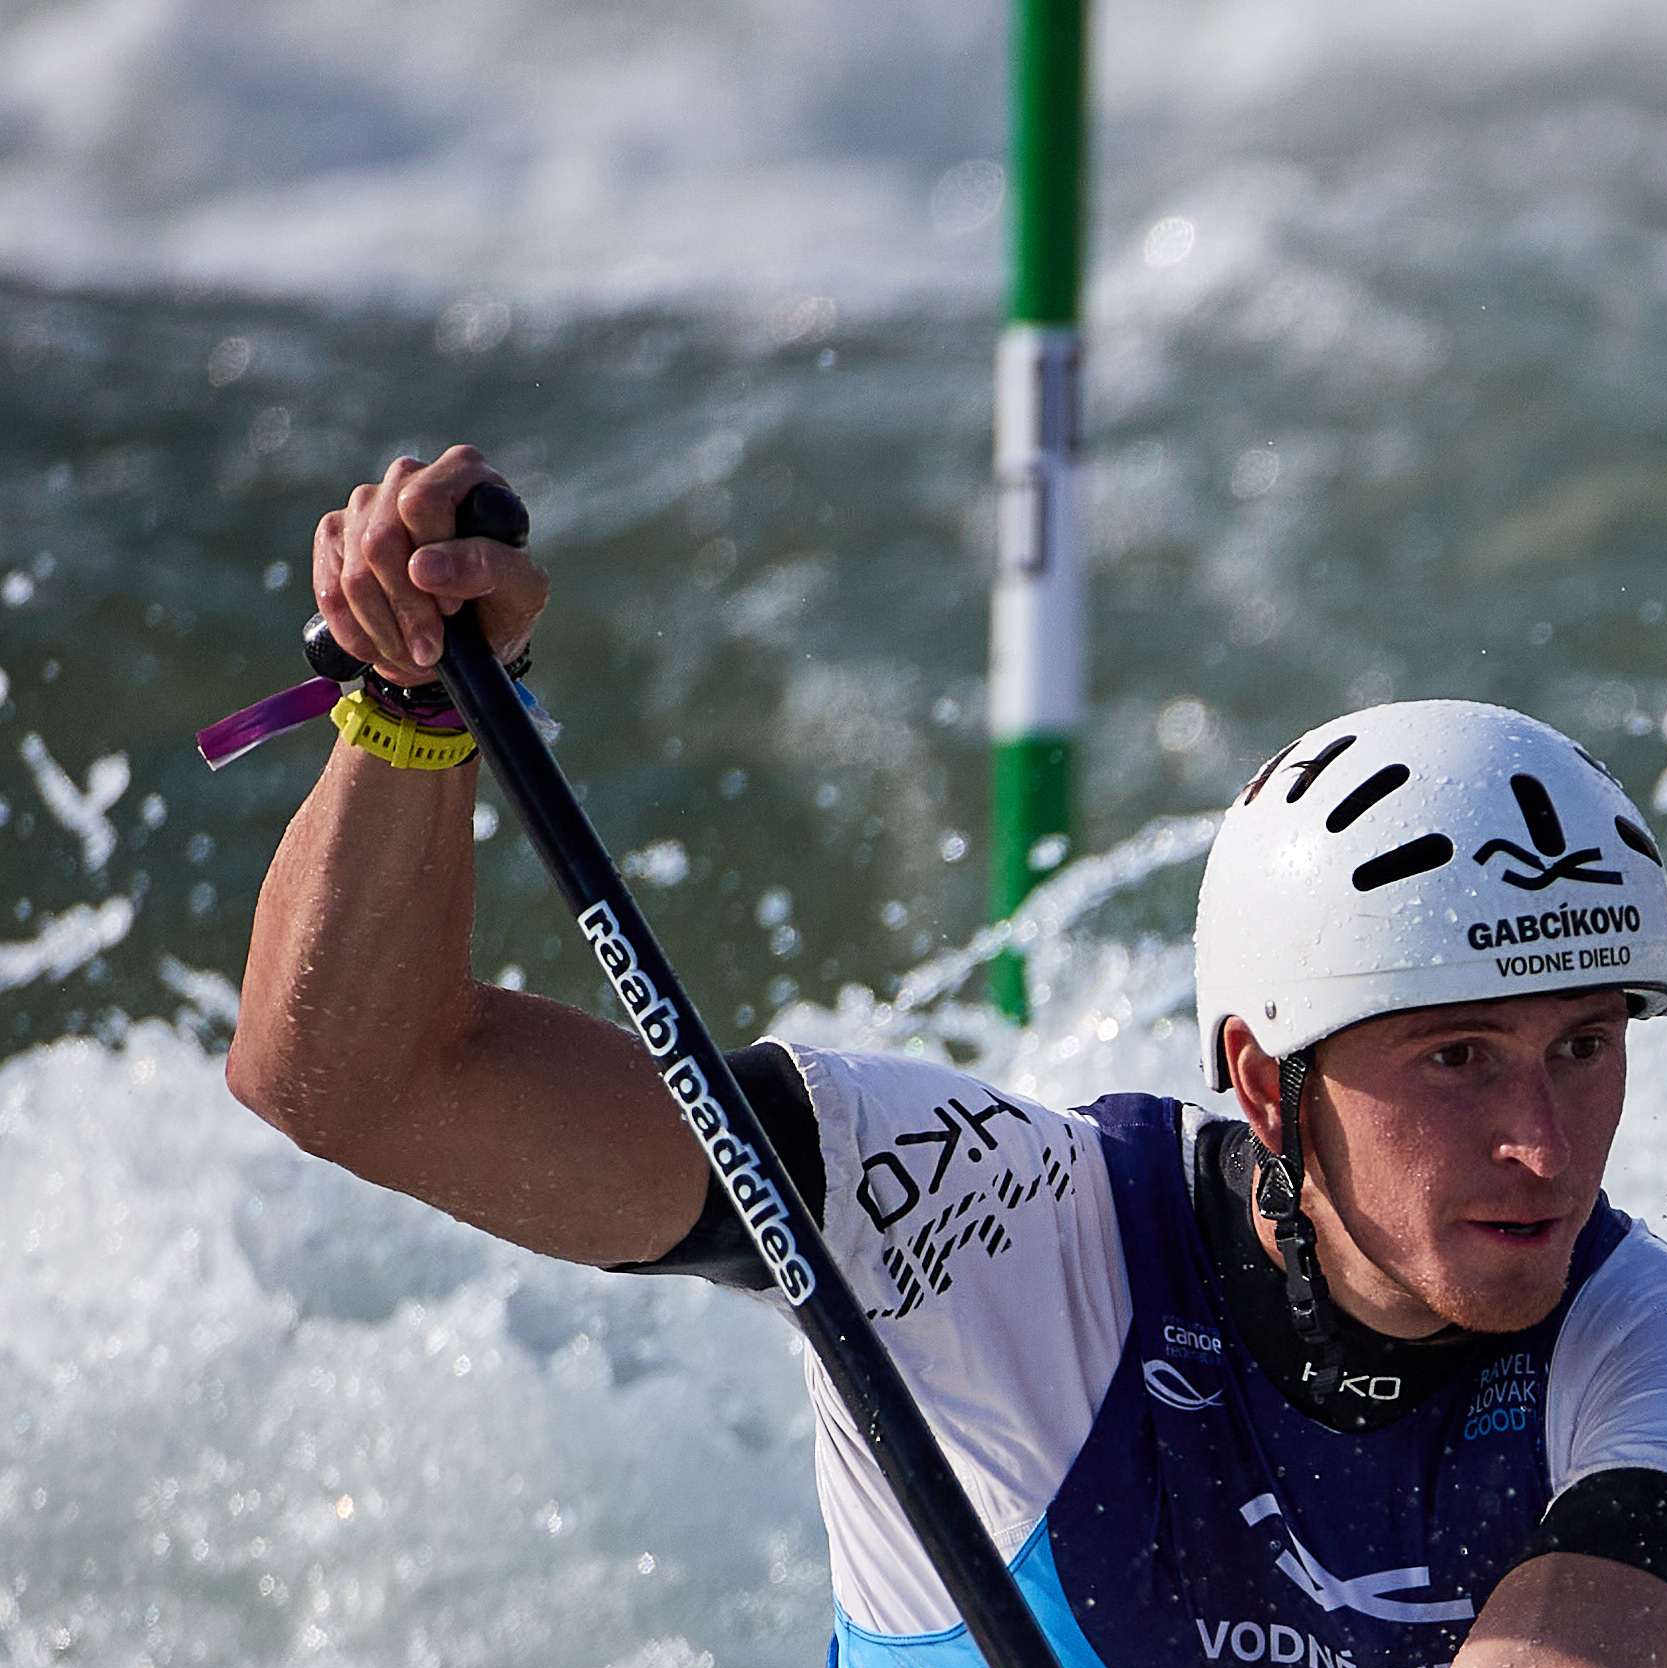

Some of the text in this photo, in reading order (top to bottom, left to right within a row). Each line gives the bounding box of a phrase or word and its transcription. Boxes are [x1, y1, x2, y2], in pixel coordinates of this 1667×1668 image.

[1496, 945, 1631, 977] VODNE DIELO
[577, 898, 817, 1307] raab paddles
[1163, 1324, 1222, 1357] canoe
[1463, 1407, 1527, 1441] GOOD
